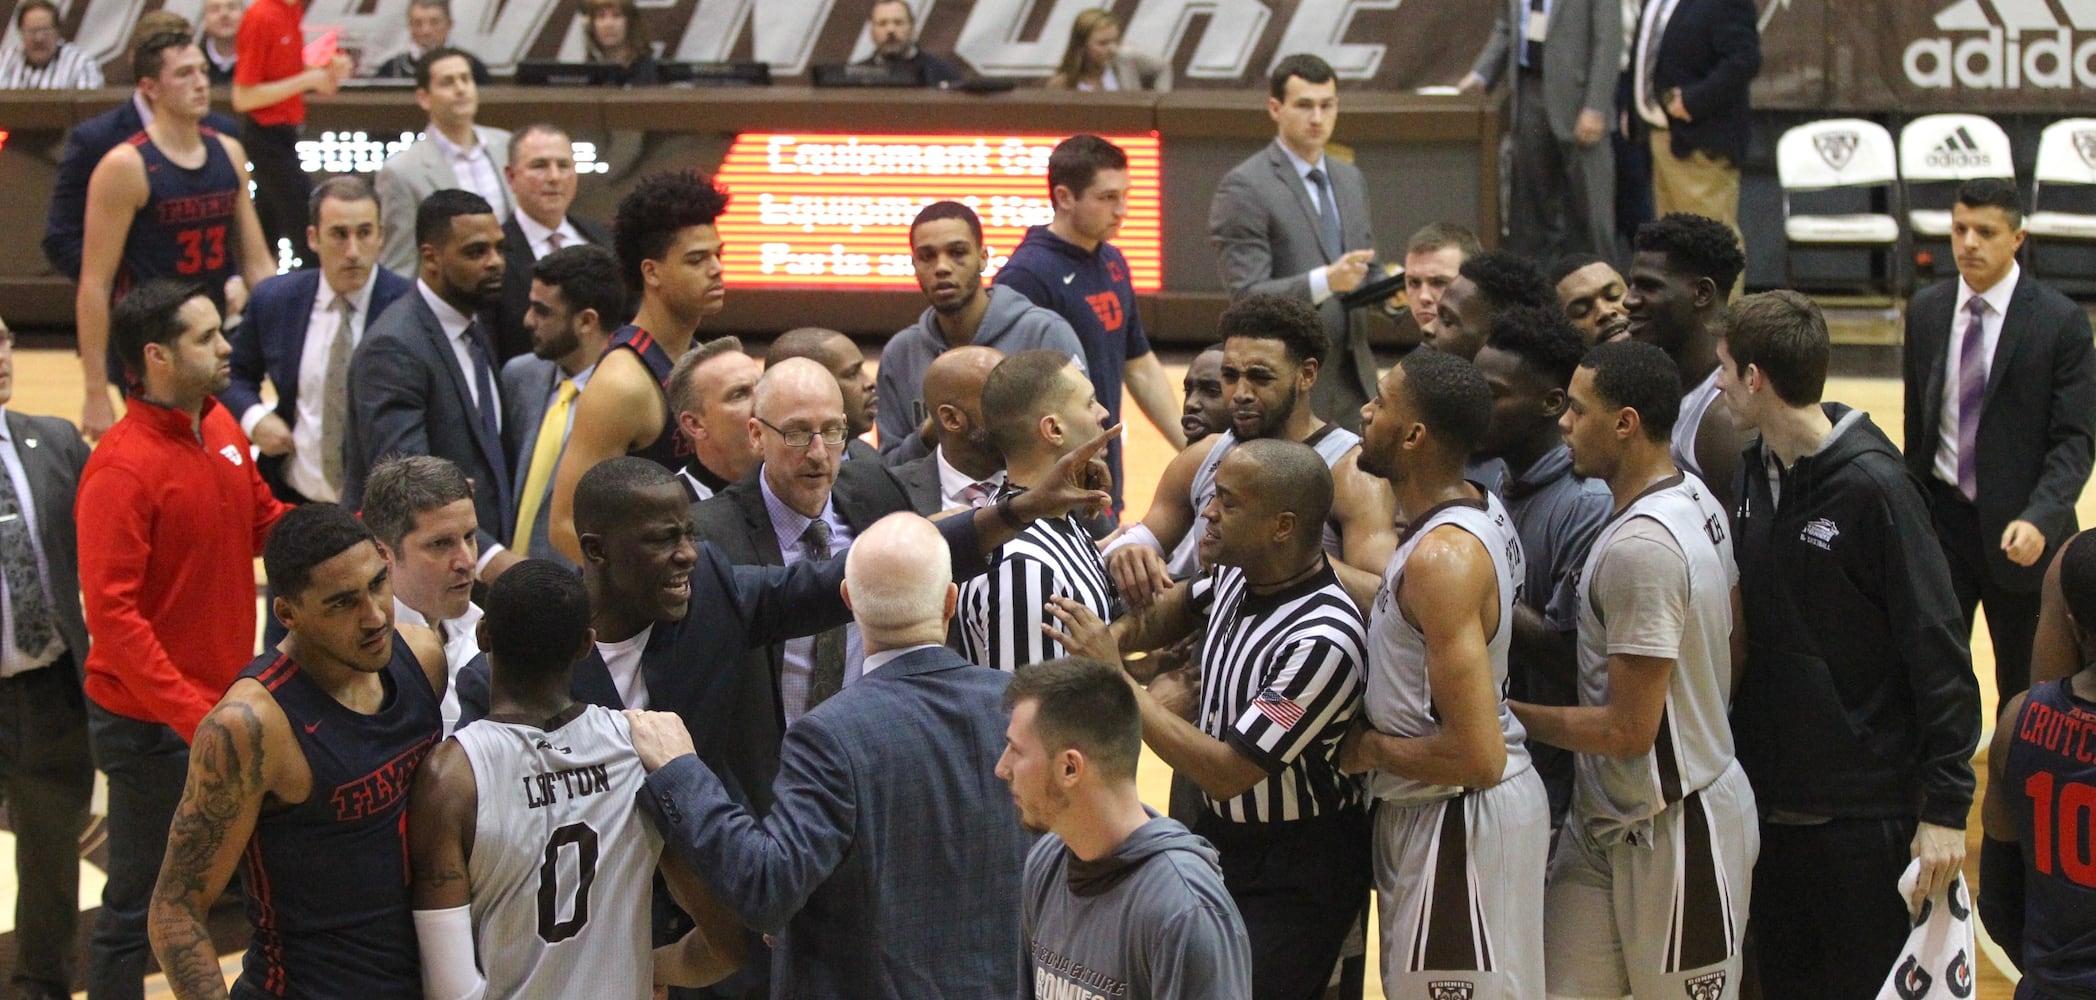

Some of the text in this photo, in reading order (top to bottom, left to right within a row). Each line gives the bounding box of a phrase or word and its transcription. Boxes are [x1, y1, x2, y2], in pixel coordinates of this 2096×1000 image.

[1925, 151, 1992, 168] adidas
[176, 226, 226, 275] 33
[759, 242, 872, 276] Parts
[2020, 701, 2096, 765] CRUTC
[523, 763, 611, 809] LOFTON
[2024, 770, 2096, 888] 10
[536, 821, 600, 943] 0
